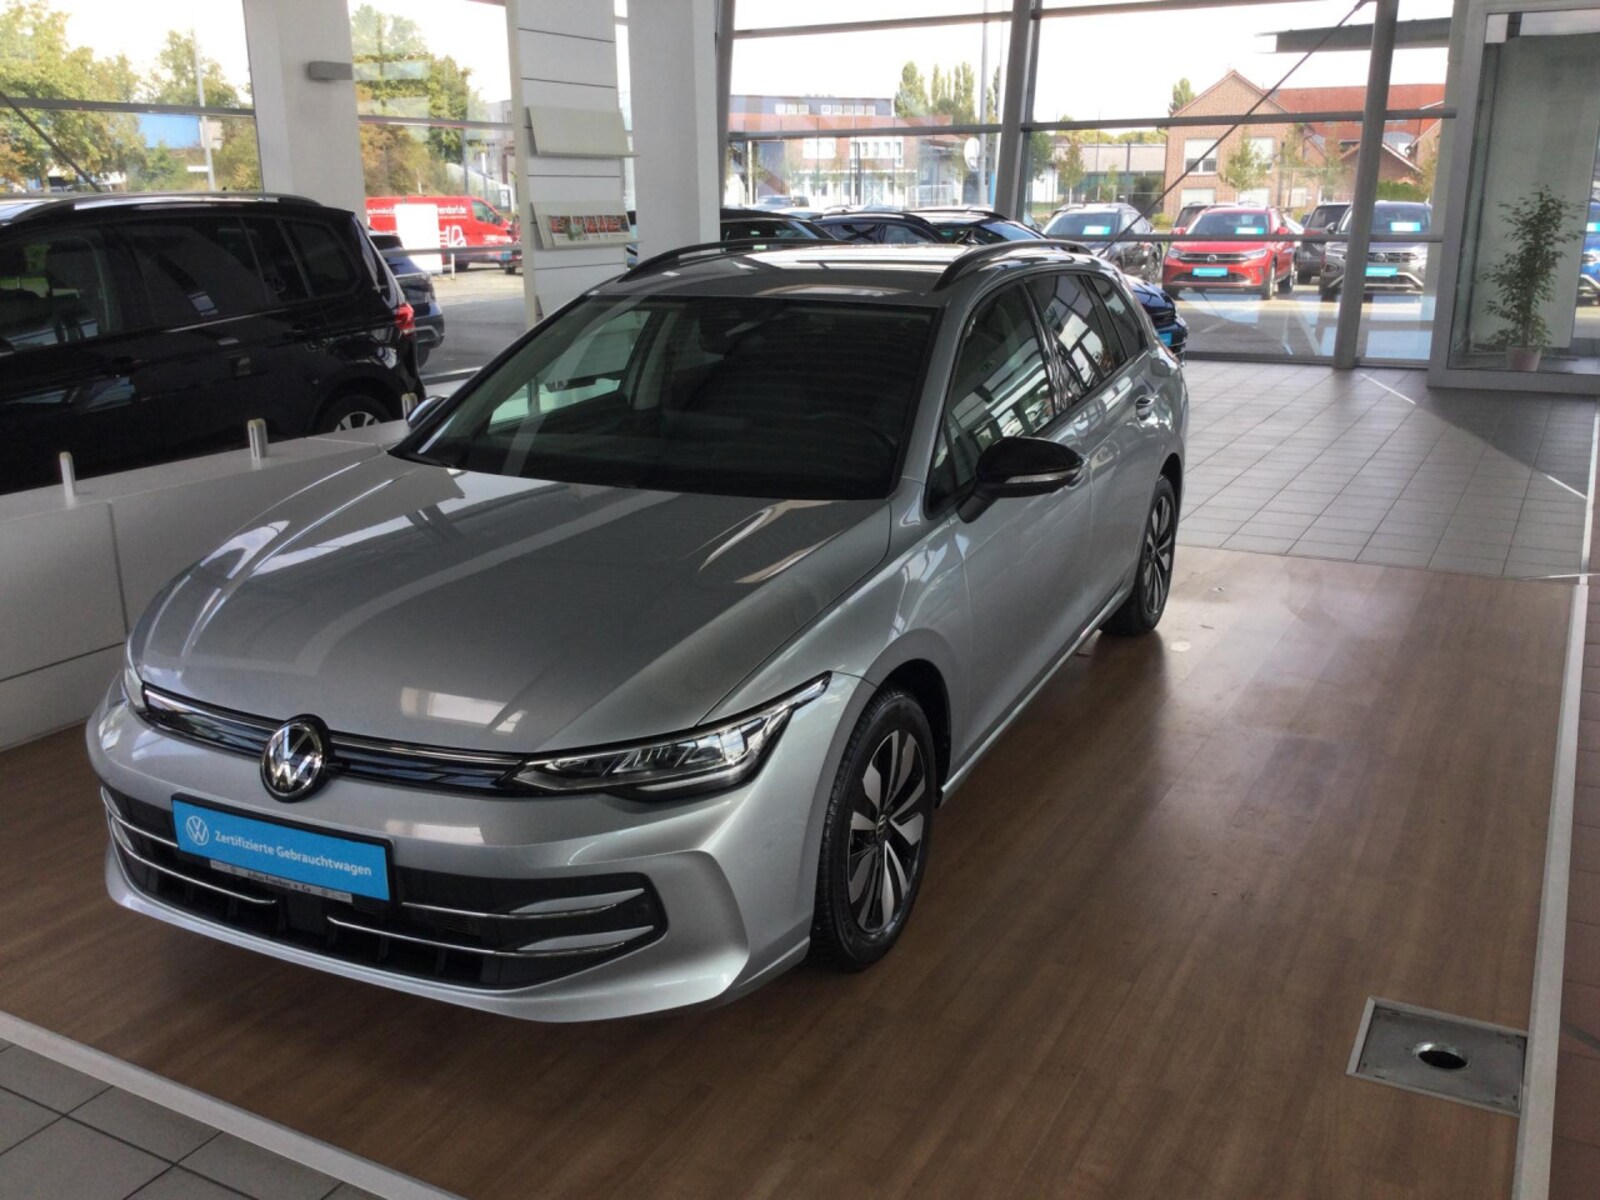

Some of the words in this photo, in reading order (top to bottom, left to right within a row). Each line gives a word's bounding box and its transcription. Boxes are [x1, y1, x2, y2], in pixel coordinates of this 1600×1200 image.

[185, 815, 209, 846] VW
[215, 830, 275, 855] Zertifizierte
[276, 846, 372, 876] Gebrauchtwagen
